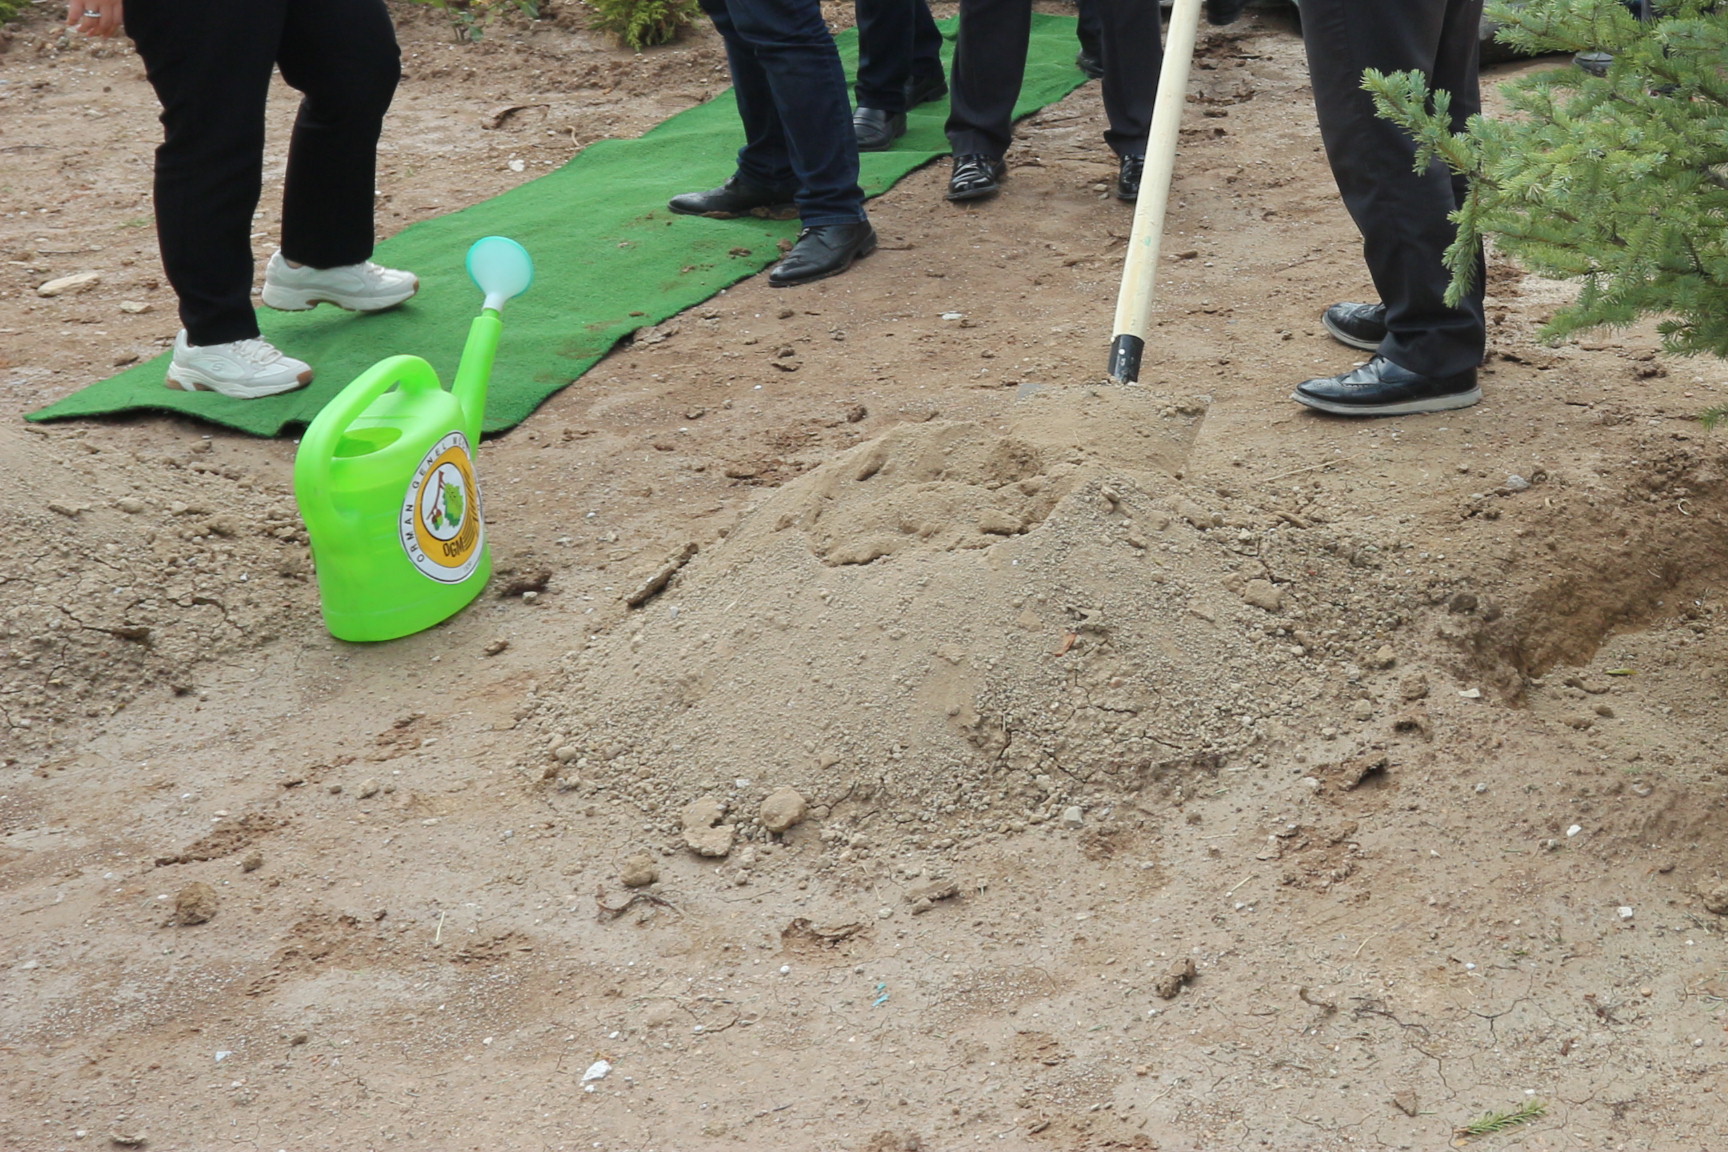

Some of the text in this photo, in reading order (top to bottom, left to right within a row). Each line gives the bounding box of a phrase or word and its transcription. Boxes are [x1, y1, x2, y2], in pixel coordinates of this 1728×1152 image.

[404, 441, 448, 563] ORMAN GENEL
[442, 536, 465, 558] OGM
